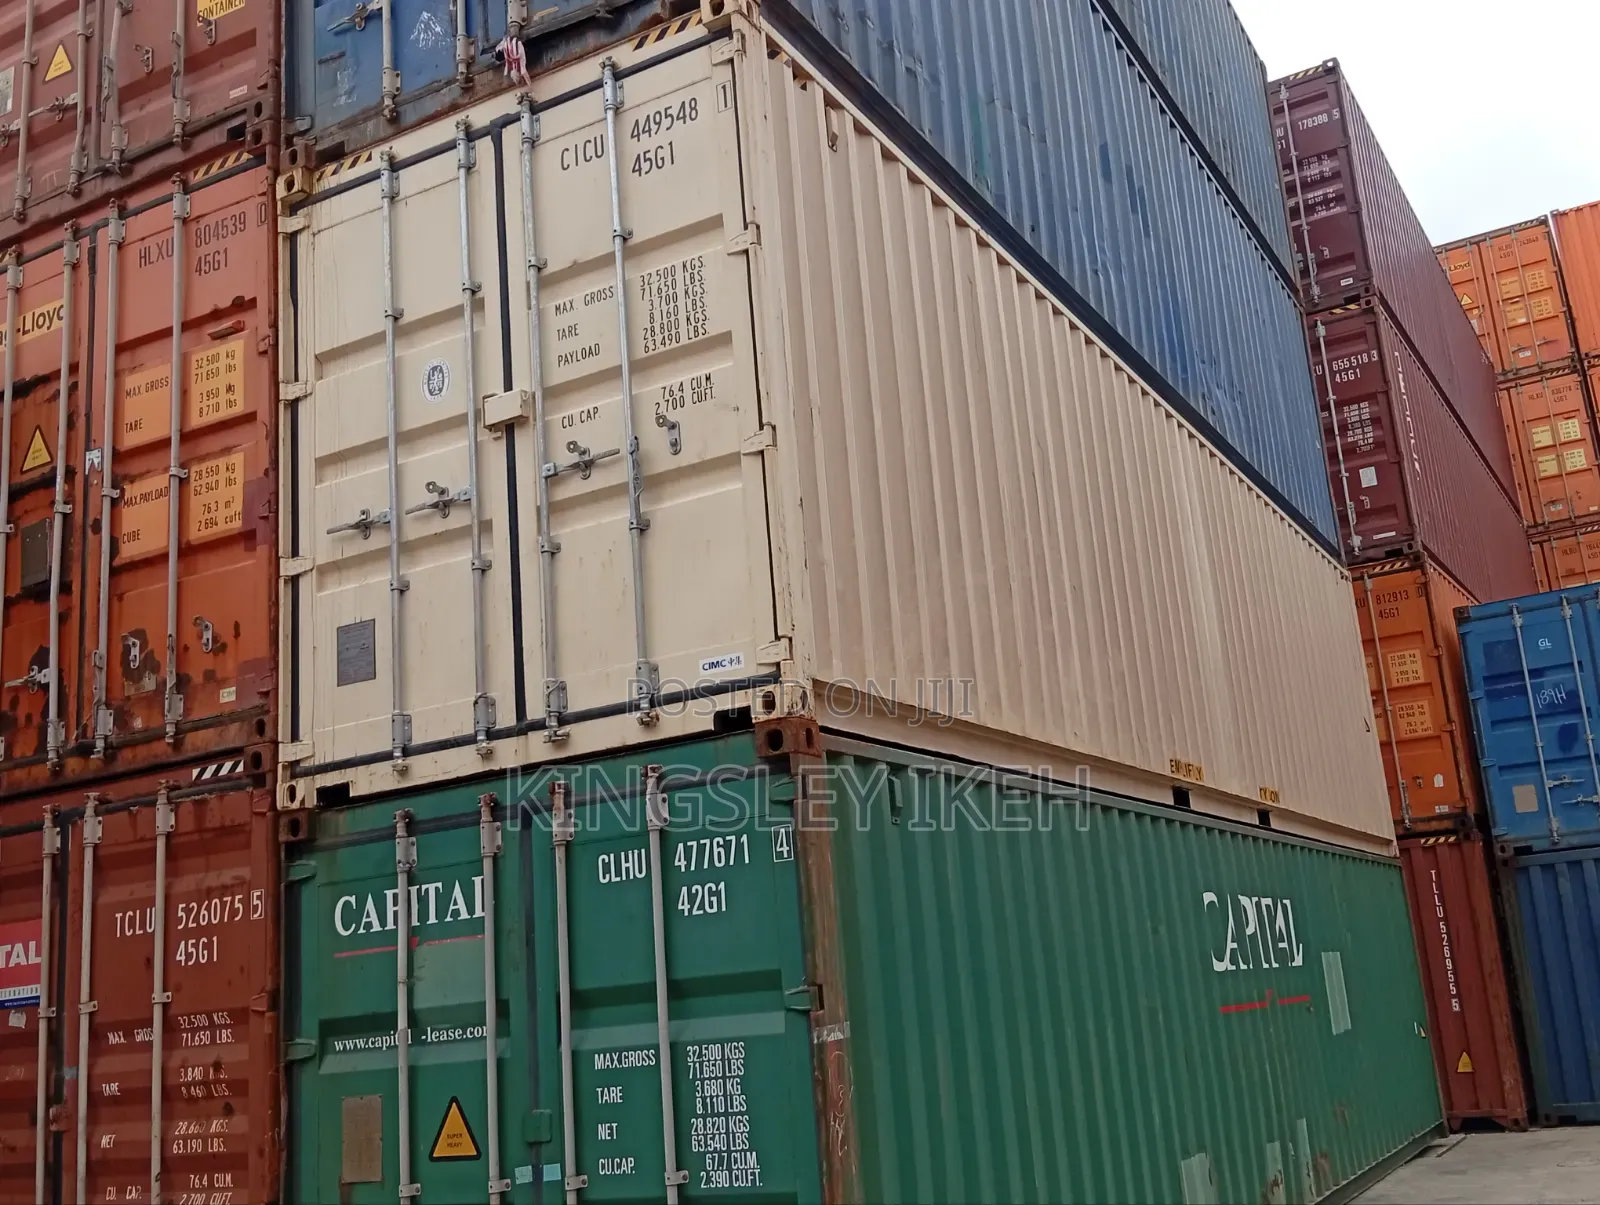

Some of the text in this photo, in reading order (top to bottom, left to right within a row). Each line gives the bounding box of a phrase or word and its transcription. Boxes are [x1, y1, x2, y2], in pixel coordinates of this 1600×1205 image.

[1297, 112, 1329, 131] 178388
[560, 133, 605, 171] CICU
[630, 96, 699, 143] 449548
[631, 141, 675, 178] 45G1
[138, 237, 174, 269] HLXU
[194, 211, 247, 249] 804539
[194, 247, 229, 277] 45G1
[639, 255, 707, 289] 32.500 KGS.
[640, 269, 706, 302] 71.650 LBS.
[554, 285, 615, 317] MAX. GROSS
[649, 282, 708, 312] 3.700 KGS.
[649, 296, 708, 325] 8.160 LBS.
[556, 323, 580, 342] TARE
[643, 309, 710, 342] 28.800 KGS.
[643, 323, 710, 355] 63.490 LBS.
[225, 349, 236, 361] kg
[557, 343, 601, 368] PAYLOAD
[1332, 352, 1369, 372] 655518
[225, 362, 237, 375] lbs
[1335, 368, 1361, 383] 45G1
[125, 376, 169, 400] MAX. GROSS
[661, 381, 685, 400] 76.4
[225, 397, 238, 410] lbs
[655, 397, 686, 416] 2.700
[125, 418, 144, 434] TARE
[561, 406, 602, 430] CU. CAP.
[225, 461, 236, 475] kg
[225, 475, 237, 488] lbs
[224, 510, 242, 525] cuft
[122, 529, 141, 545] CUBE
[1375, 589, 1410, 605] 812913
[1378, 606, 1400, 619] 45G1
[1538, 637, 1552, 647] GL
[702, 658, 727, 671] CIMC
[1536, 684, 1567, 709] 189H
[598, 847, 647, 884] CLHU
[674, 833, 750, 873] 477671
[678, 880, 727, 917] 42G1
[115, 906, 156, 938] TCLU
[176, 894, 244, 930] 526075
[1202, 891, 1303, 972] CAPITAL
[1430, 870, 1444, 918] TLLU
[1439, 921, 1457, 995] 526955
[175, 936, 219, 967] 45G1
[177, 1011, 234, 1029] 32.500 KGS.
[107, 1027, 155, 1045] MAX. GROS
[181, 1028, 235, 1047] 71.650 LBS.
[594, 1049, 656, 1071] MAX.GROSS
[686, 1041, 746, 1063] 32.500 KGS
[179, 1064, 228, 1082] 3.840 KS.
[687, 1058, 745, 1080] 71.650 LBS
[102, 1082, 121, 1097] TARE
[211, 1083, 233, 1097] LBS.
[596, 1086, 624, 1105] TARE
[695, 1078, 742, 1098] 3.680 KG
[695, 1095, 748, 1115] 8.110 LBS
[209, 1118, 229, 1134] KGS.
[597, 1122, 618, 1141] NET
[690, 1115, 750, 1136] 28.820 KGS
[101, 1134, 117, 1149] NET
[172, 1137, 227, 1154] 63.190 LBS.
[446, 1132, 463, 1140] SUPER
[691, 1133, 750, 1153] 63.540 LBS
[705, 1153, 729, 1171] 67.7
[189, 1173, 208, 1189] 76.4
[700, 1170, 730, 1189] 2.390
[105, 1186, 117, 1201] CU.
